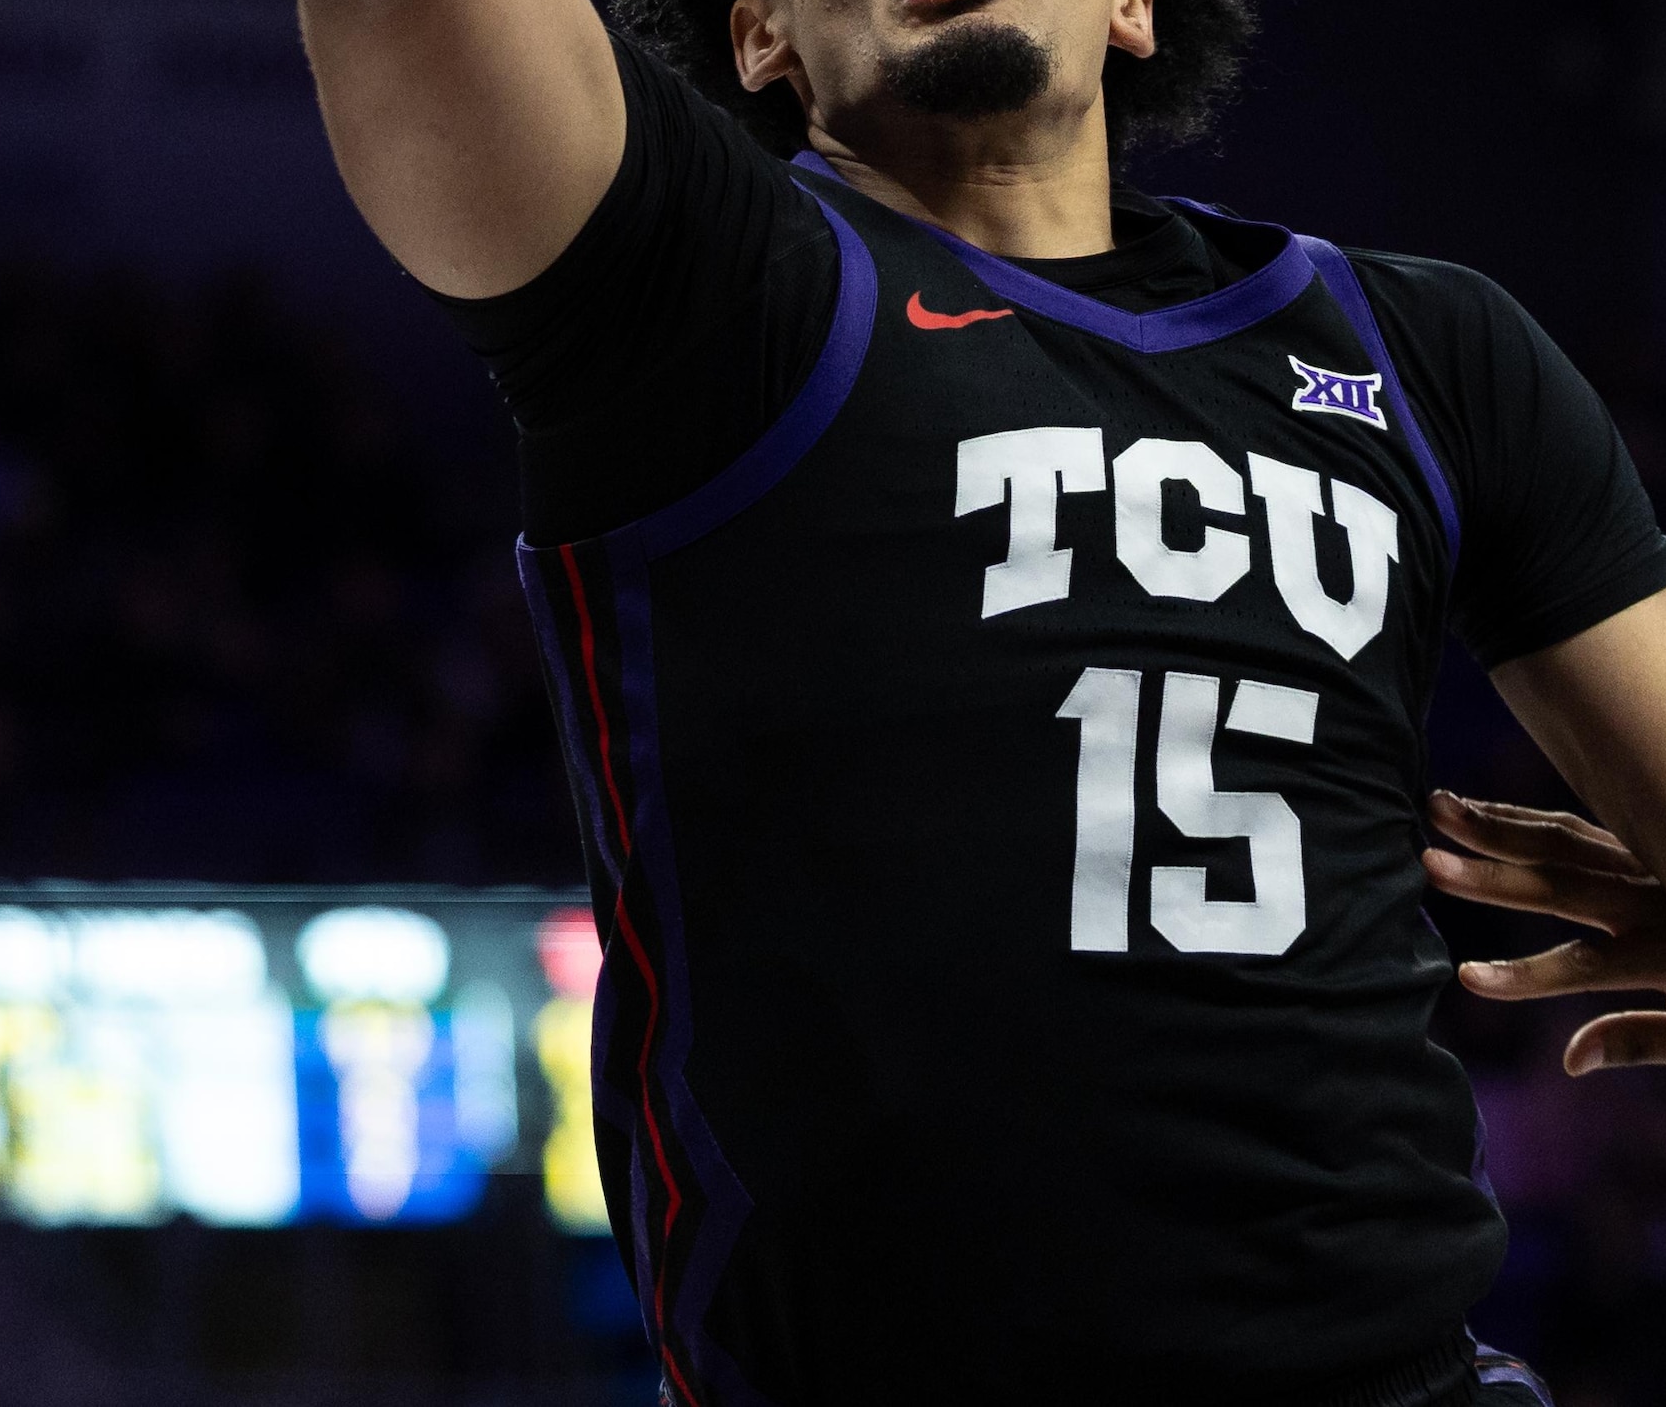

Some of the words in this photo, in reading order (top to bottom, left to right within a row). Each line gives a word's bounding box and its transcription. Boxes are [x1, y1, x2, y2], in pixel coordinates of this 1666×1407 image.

[1292, 359, 1383, 425] XII
[955, 426, 1400, 662] TCU
[1055, 666, 1320, 956] 15
